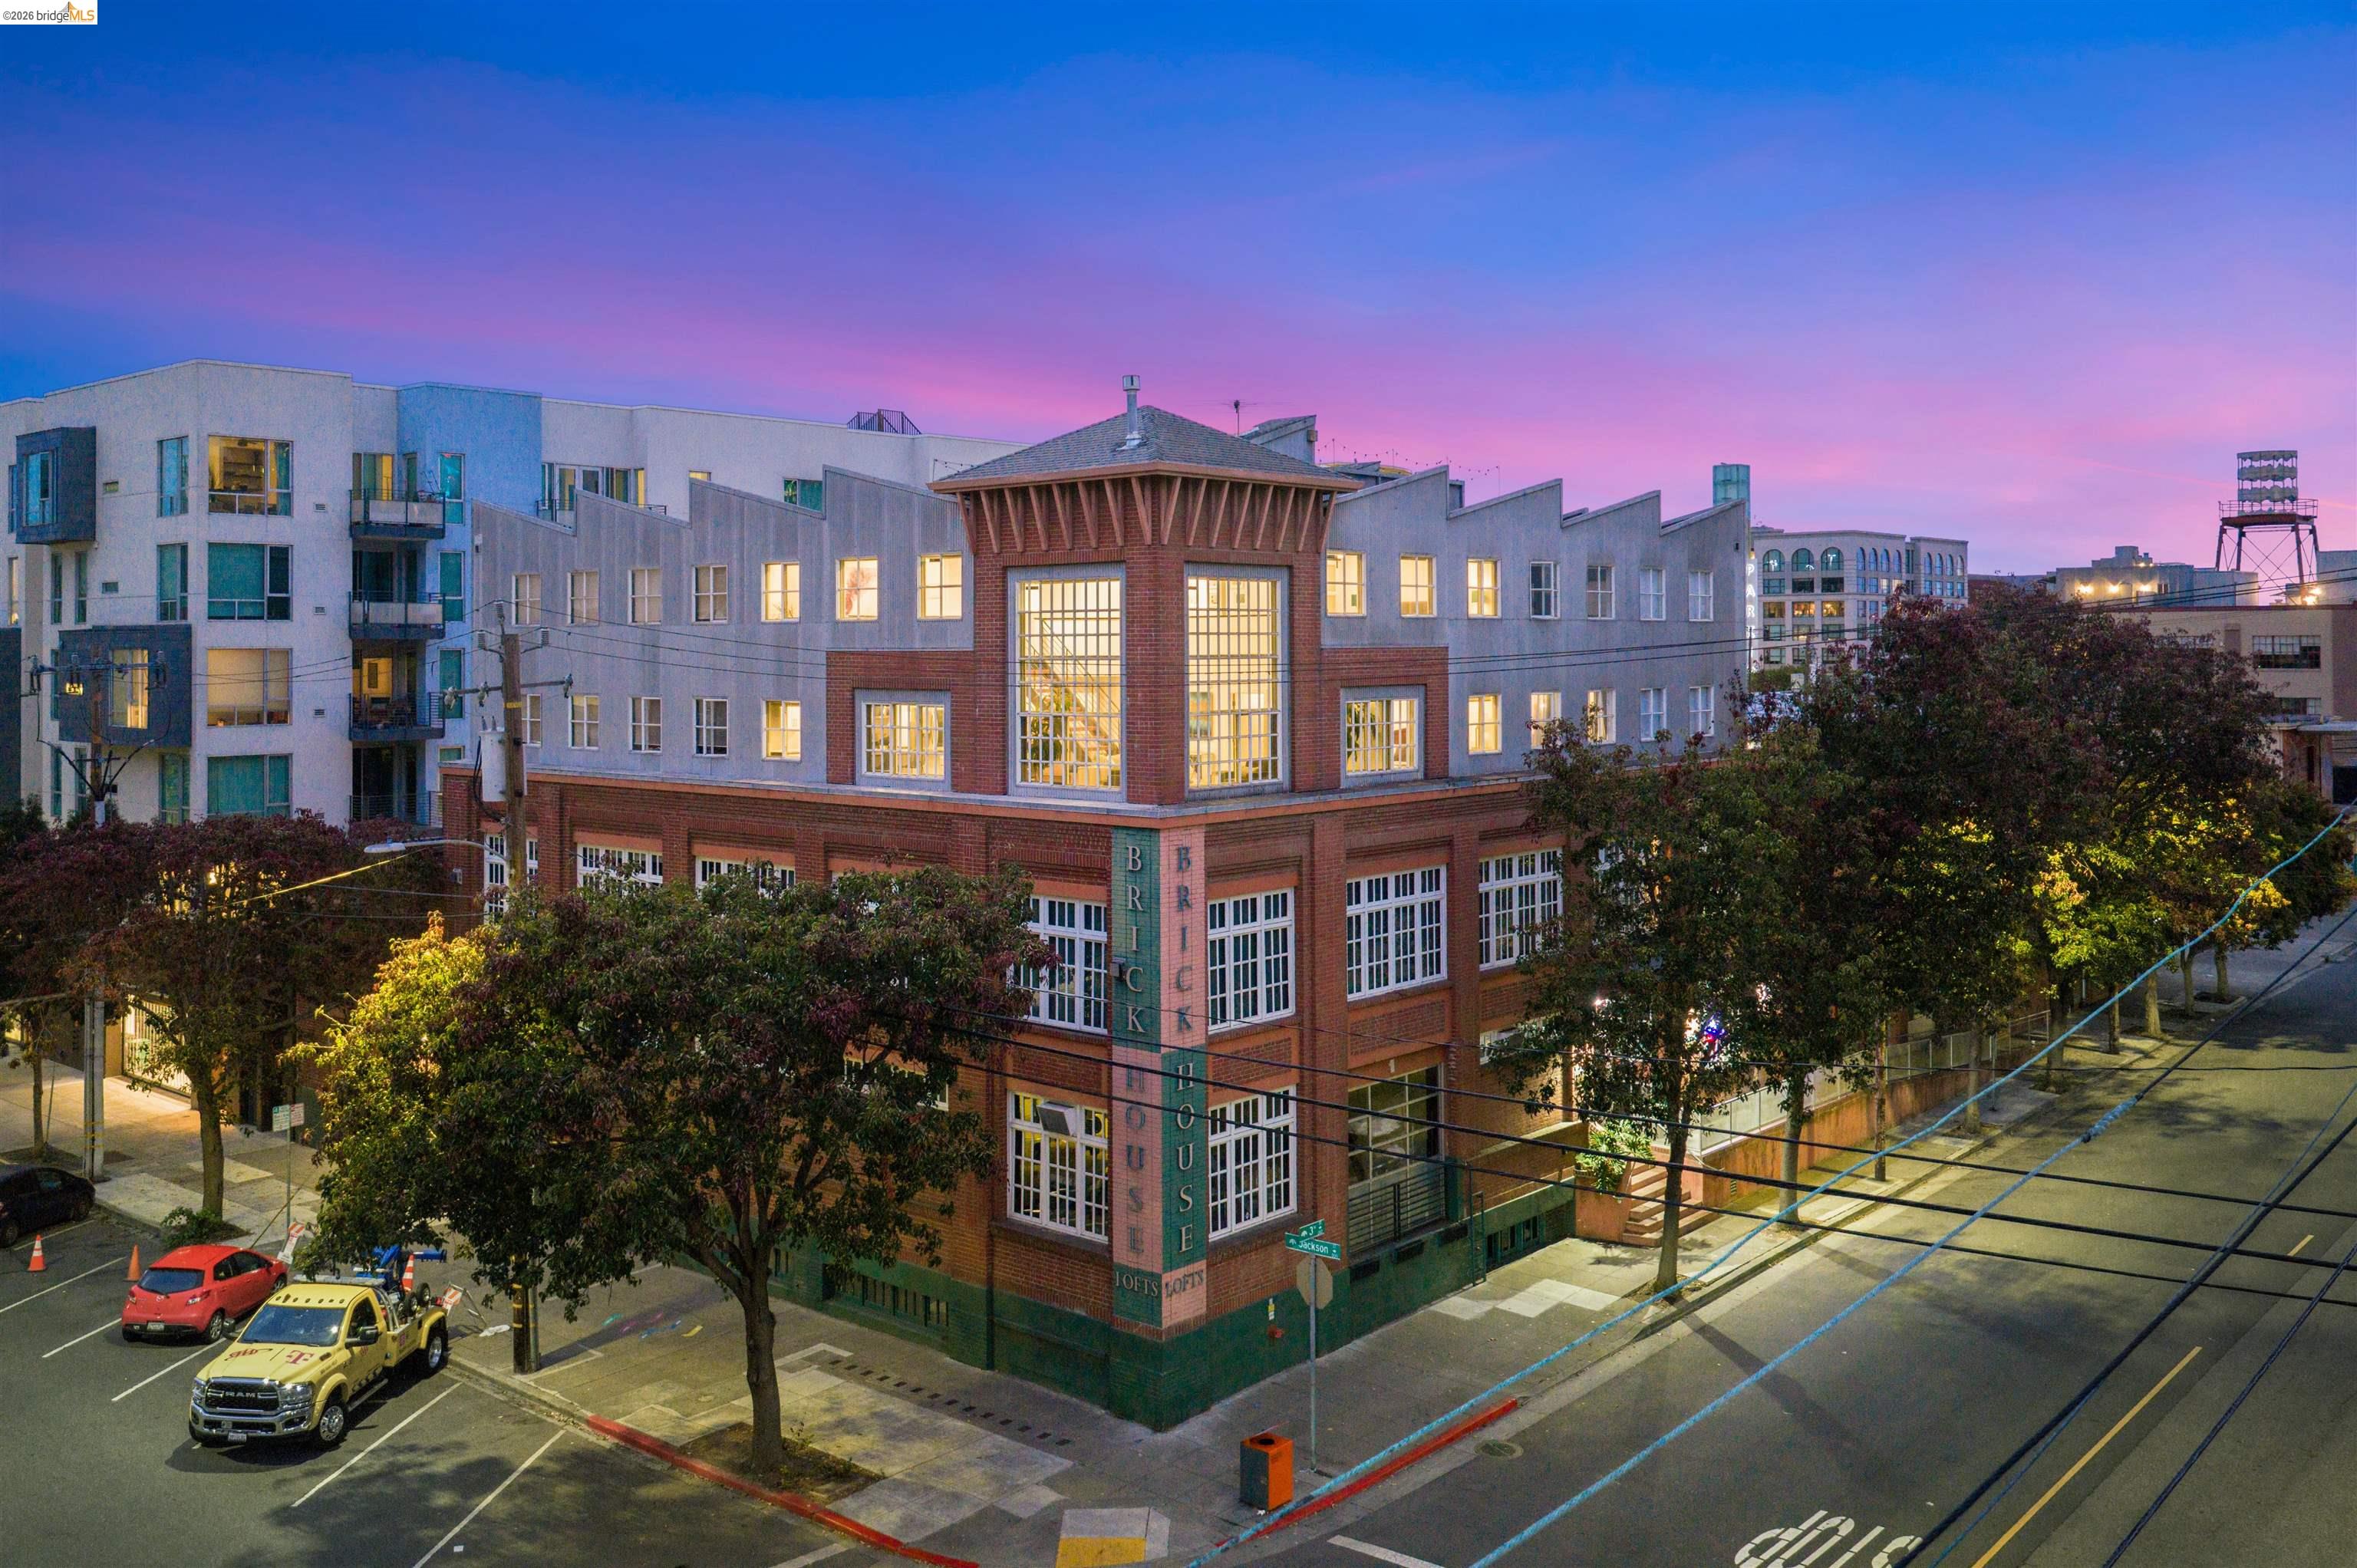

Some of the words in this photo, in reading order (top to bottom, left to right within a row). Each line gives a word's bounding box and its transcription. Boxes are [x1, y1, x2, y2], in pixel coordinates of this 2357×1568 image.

[1126, 846, 1146, 1033] BRICK
[1176, 846, 1192, 1032] BRICK
[1126, 1066, 1146, 1253] HOUSE
[1177, 1062, 1194, 1253] HOUSE
[1299, 1240, 1328, 1253] Jackson
[1165, 1270, 1204, 1297] LOFTS
